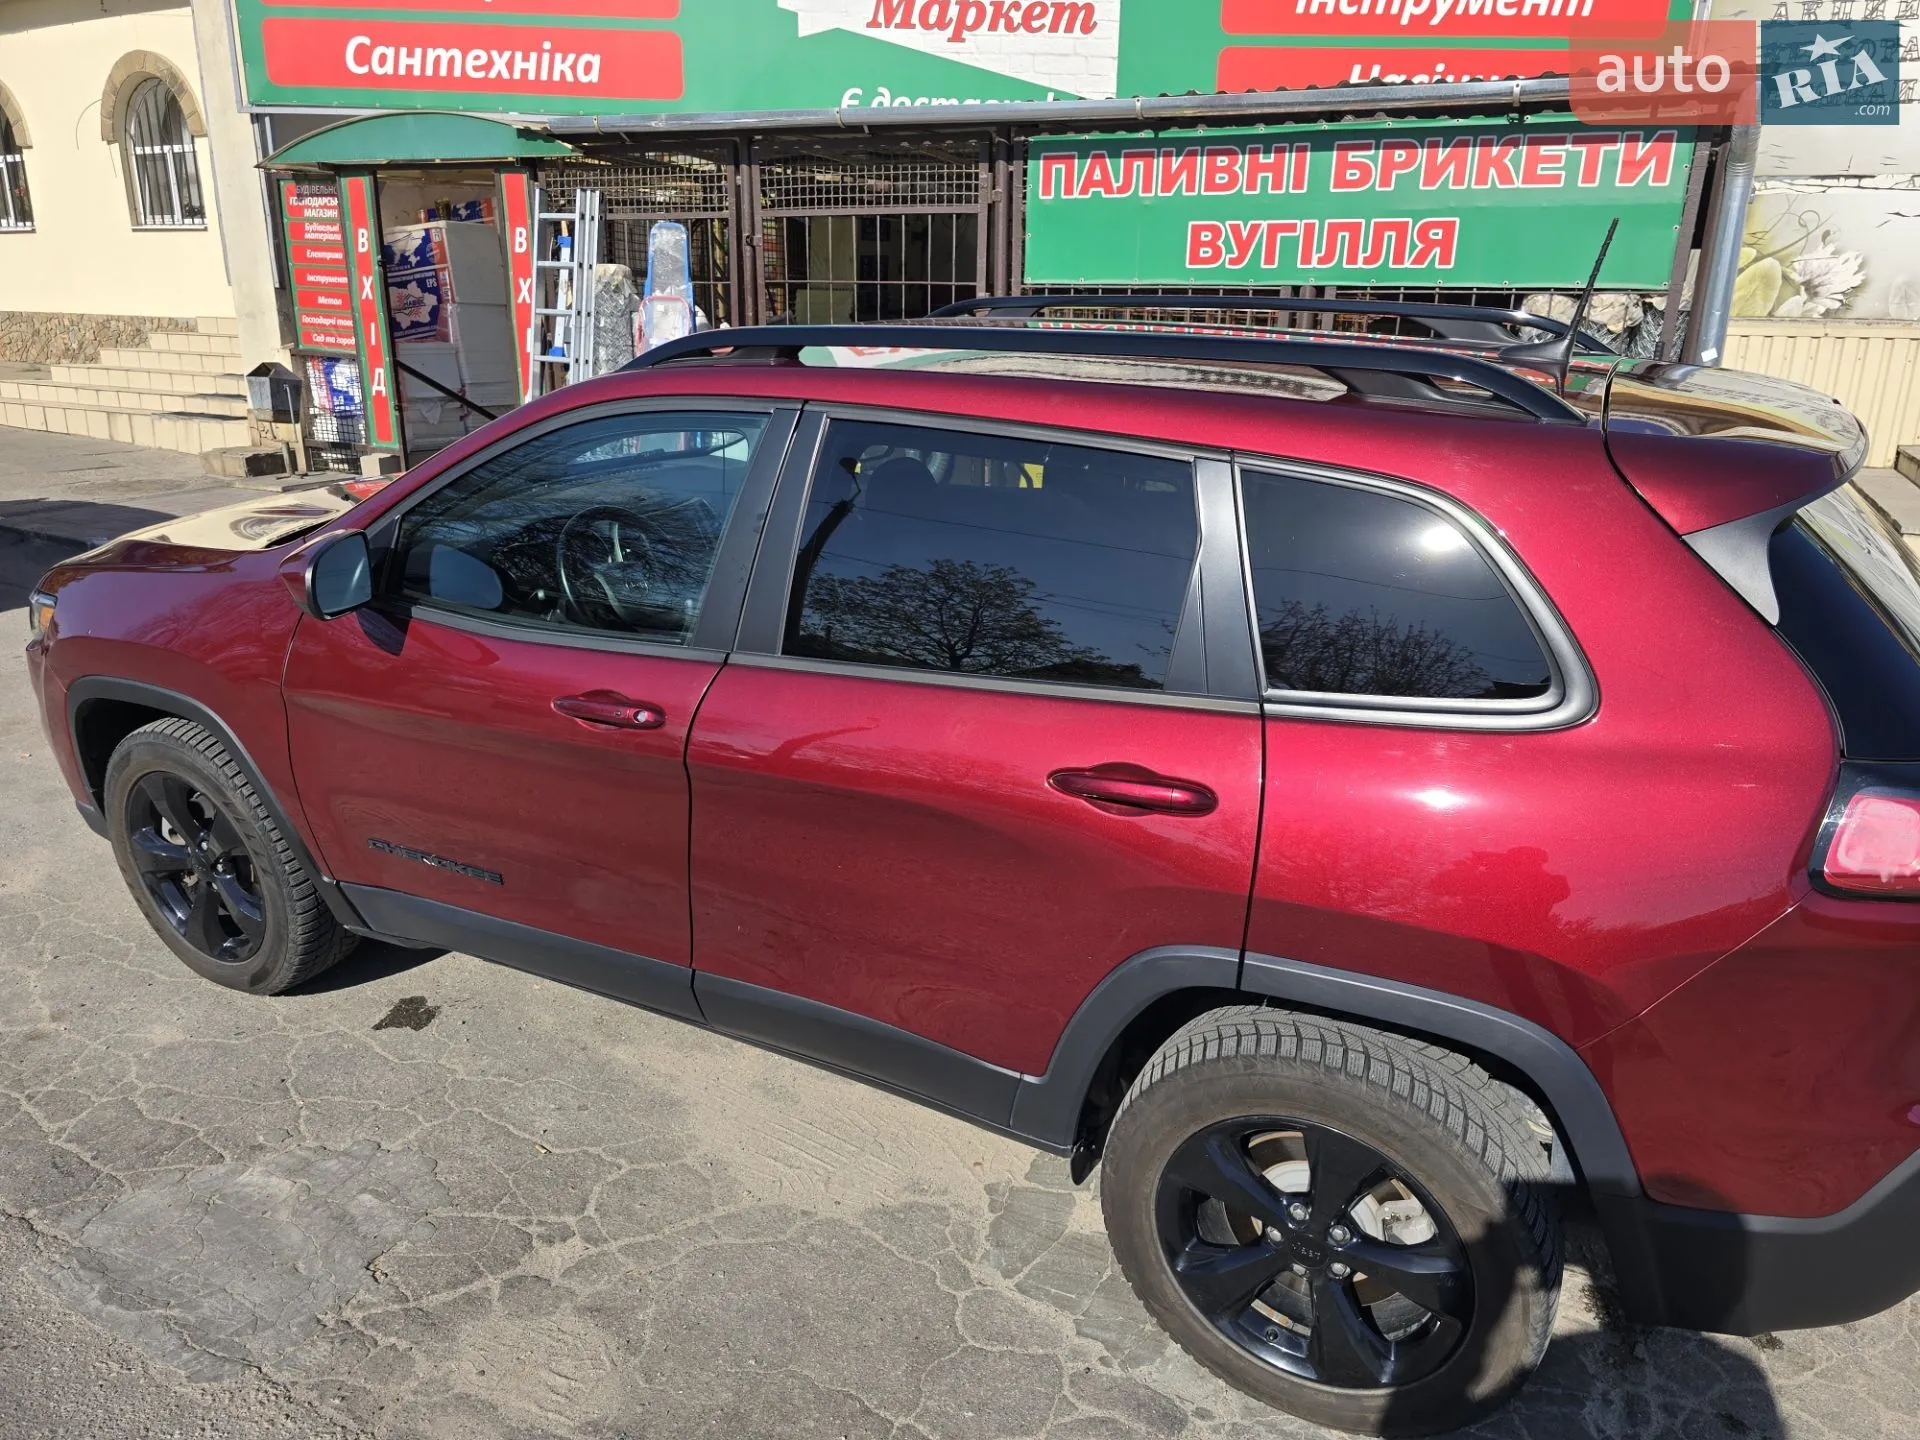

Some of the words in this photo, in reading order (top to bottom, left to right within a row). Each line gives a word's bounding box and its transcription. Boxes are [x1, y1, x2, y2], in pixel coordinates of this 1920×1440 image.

[866, 0, 1099, 43] Маркет
[345, 35, 602, 84] Сантехніка
[1038, 144, 1312, 200] ПАЛИВНІ
[1329, 131, 1678, 193] БРИКЕТИ
[304, 208, 338, 218] МАГАЗИН
[1185, 217, 1460, 270] ВУГІЛЛЯ
[425, 278, 438, 288] EPS
[317, 295, 342, 305] Метал
[356, 228, 386, 397] ВХІД
[302, 314, 336, 327] Господарчі
[312, 333, 325, 343] Сад
